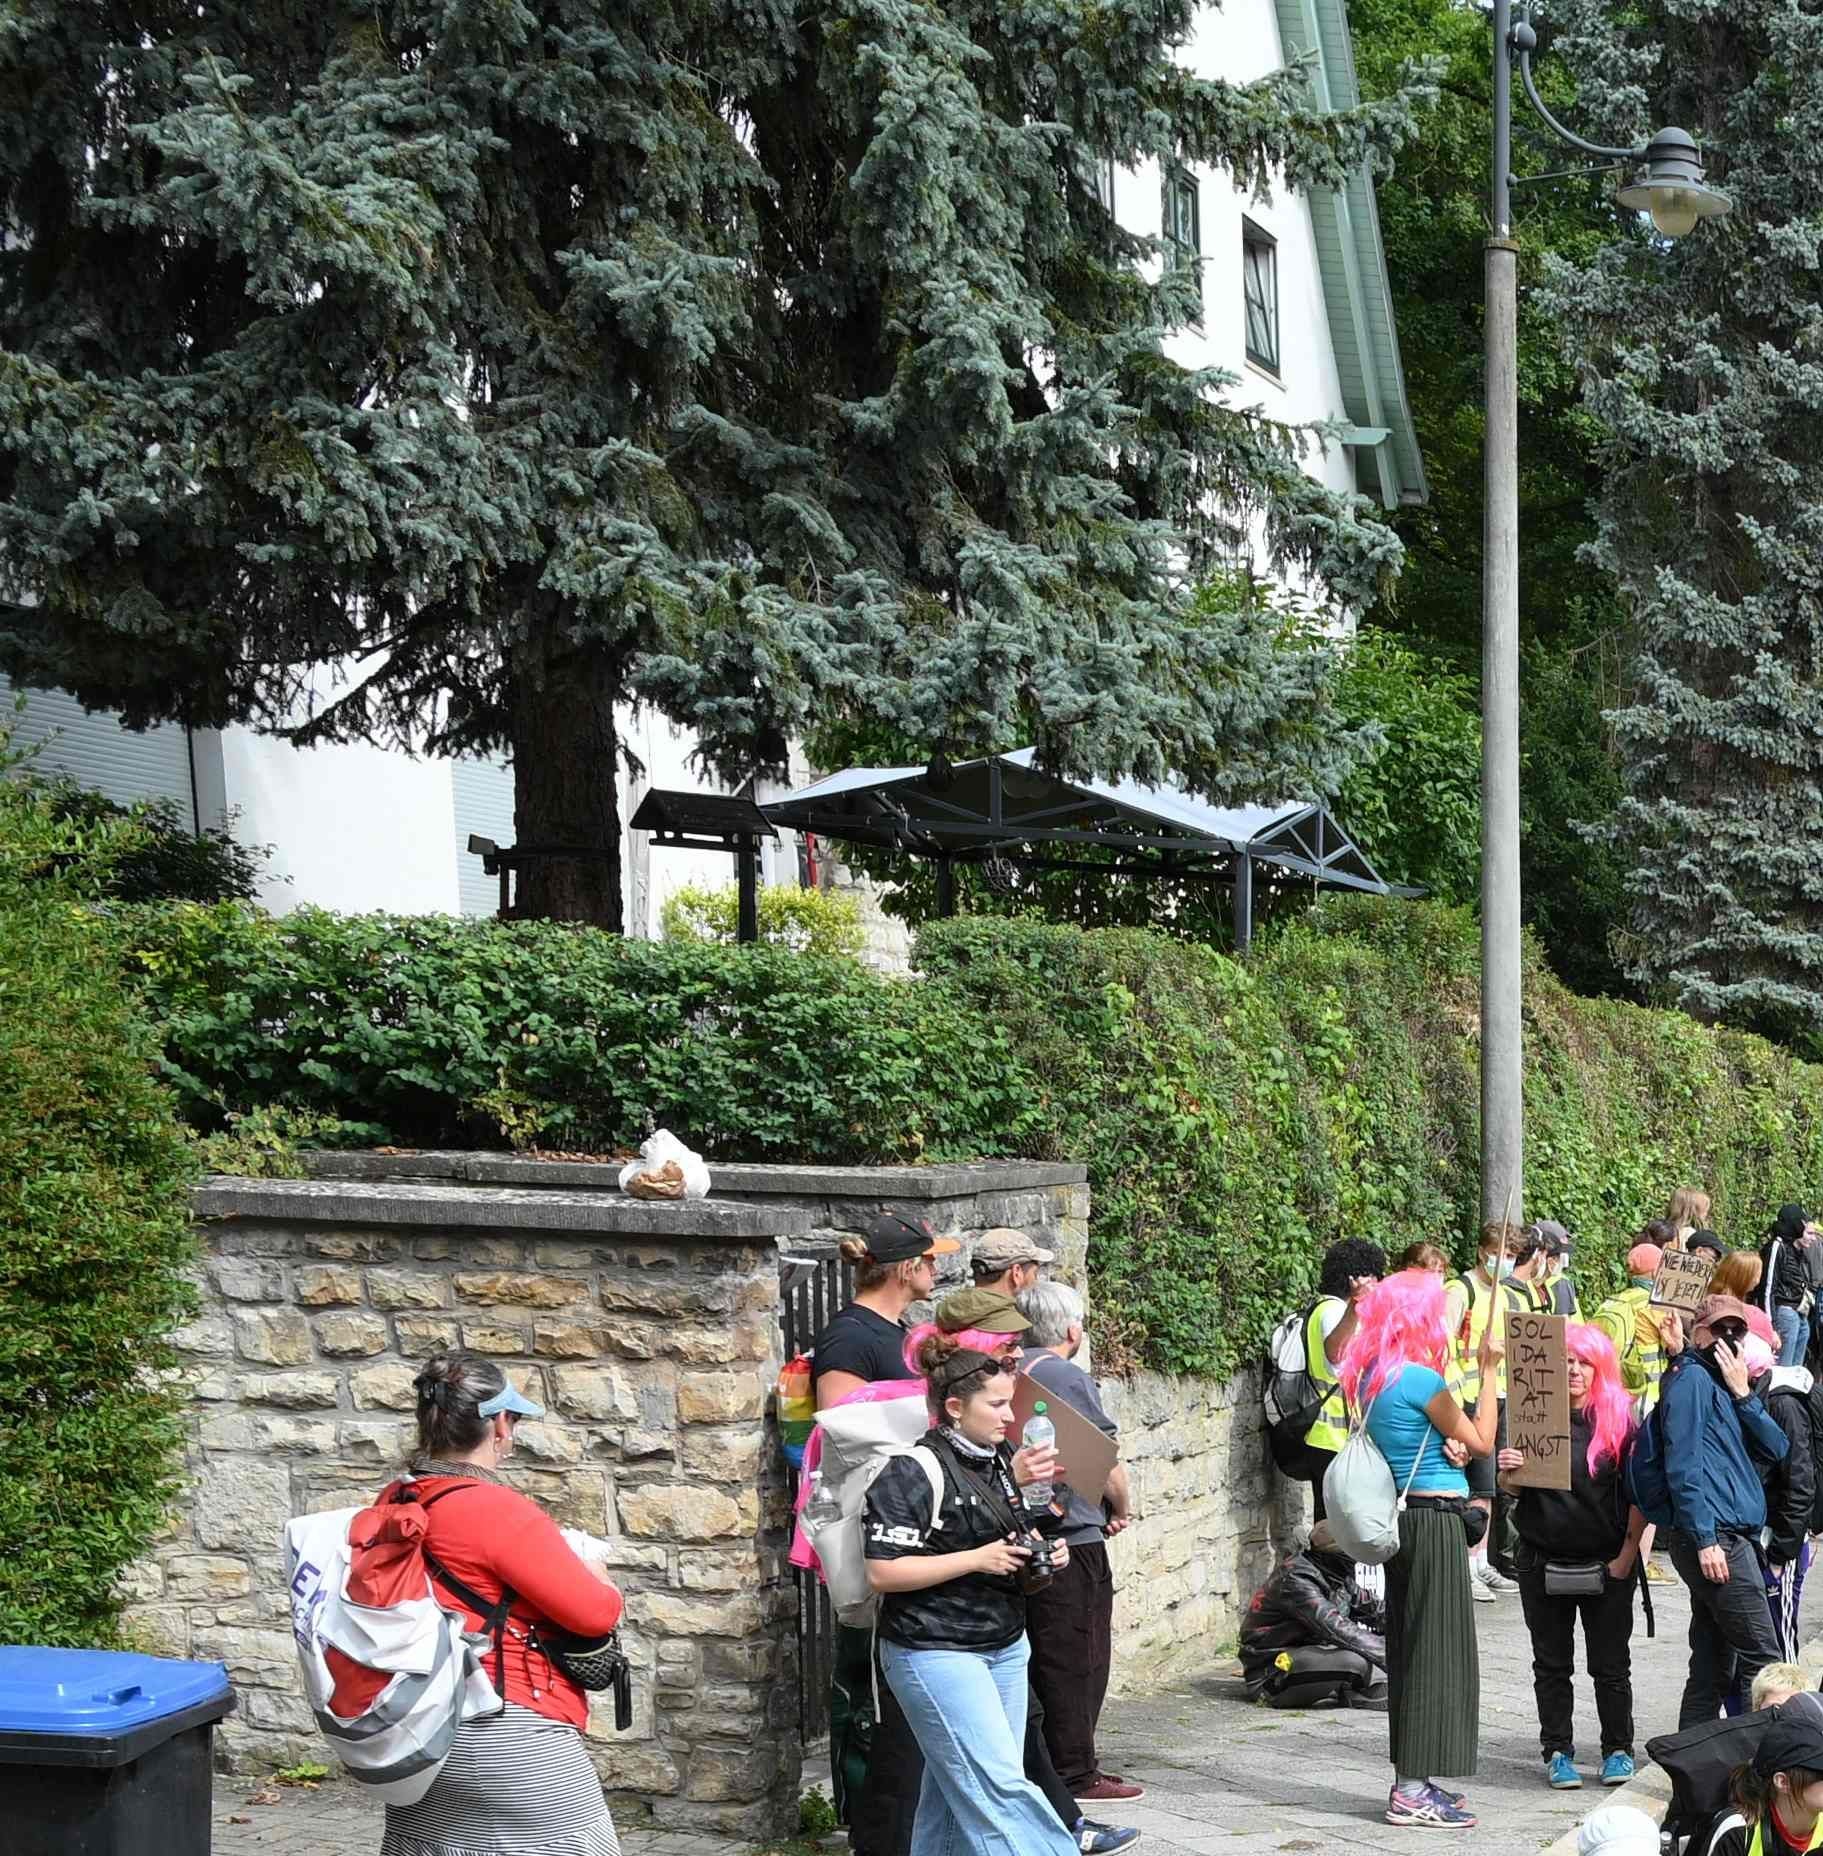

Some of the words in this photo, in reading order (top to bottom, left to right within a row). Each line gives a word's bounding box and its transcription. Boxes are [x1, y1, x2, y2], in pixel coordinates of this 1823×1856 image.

[1510, 1317, 1552, 1340] SOL
[1512, 1344, 1547, 1364] IDA
[1512, 1367, 1554, 1392] RIT
[1514, 1411, 1547, 1424] statt
[1513, 1434, 1569, 1461] ANGST
